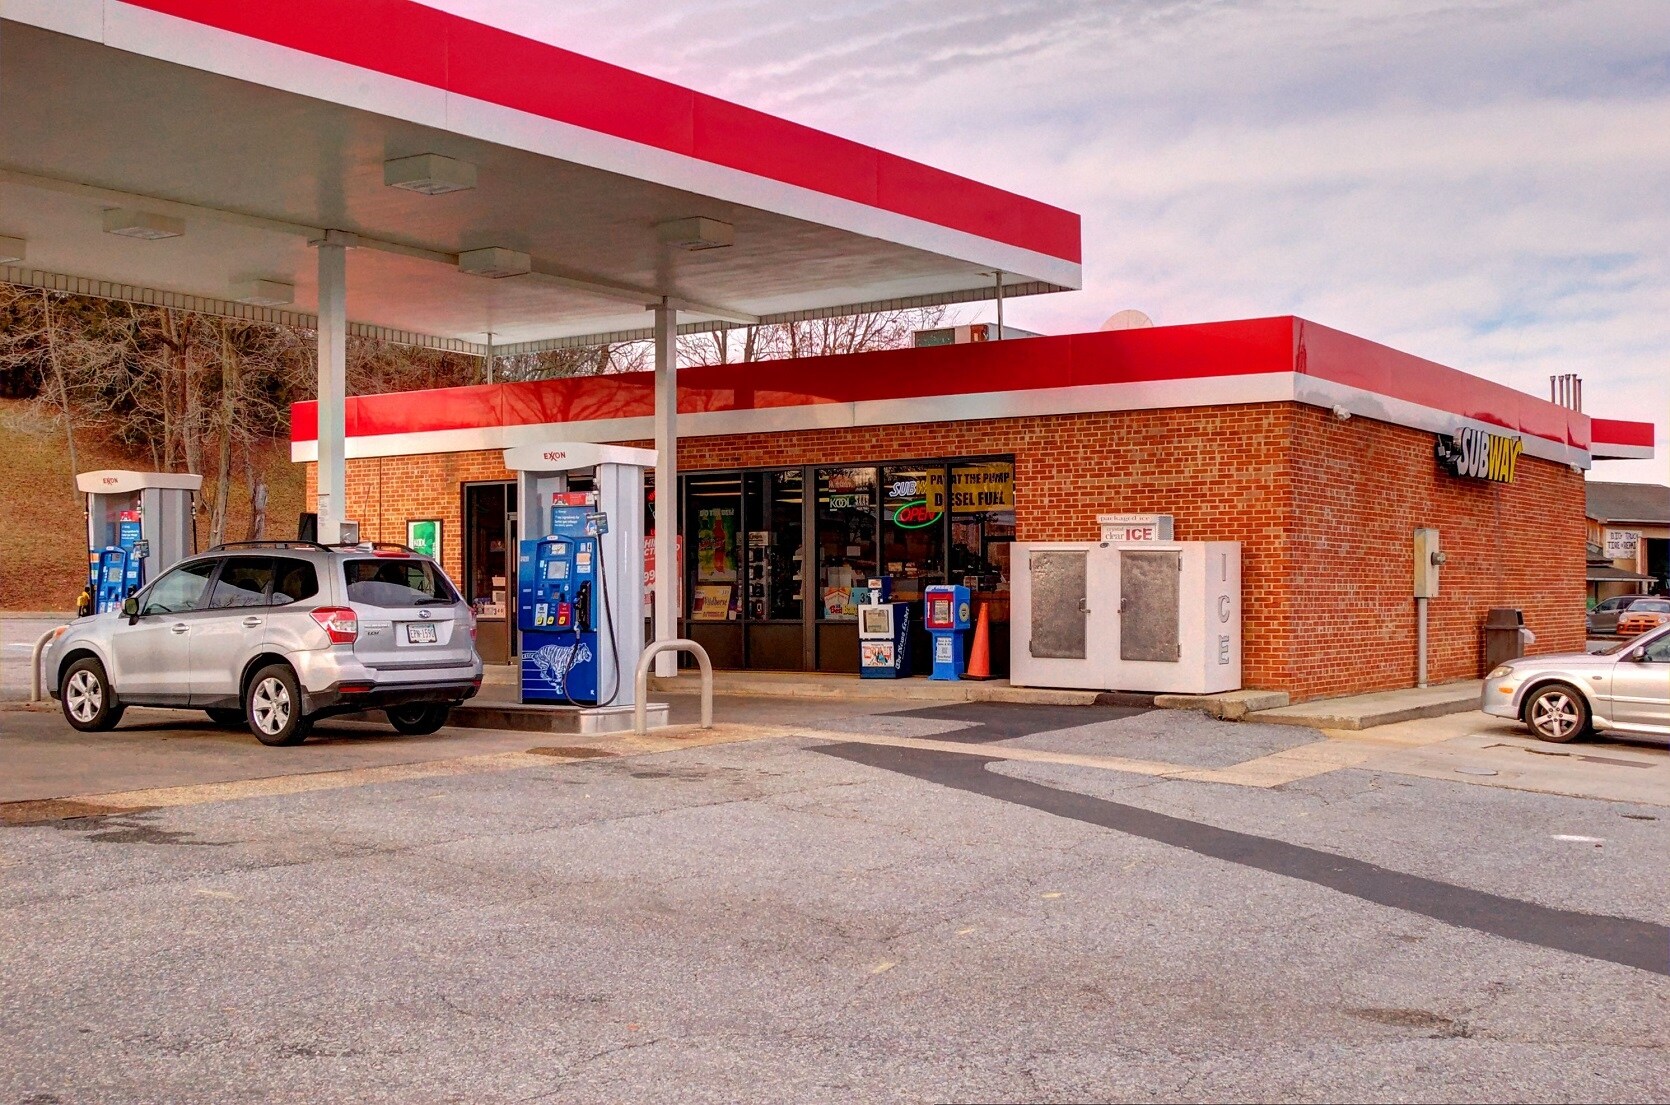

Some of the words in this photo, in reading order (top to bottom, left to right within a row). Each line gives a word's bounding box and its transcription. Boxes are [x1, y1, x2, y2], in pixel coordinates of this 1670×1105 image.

[543, 451, 566, 461] EXXON
[1457, 427, 1523, 483] SUBWAY
[103, 477, 118, 486] EXXON
[964, 473, 982, 484] THE
[983, 472, 1010, 483] PUMP
[934, 491, 975, 507] DESEL
[977, 491, 1005, 505] FUEL
[900, 506, 936, 522] OPEN
[1105, 532, 1124, 540] clear
[1125, 528, 1152, 541] ICE
